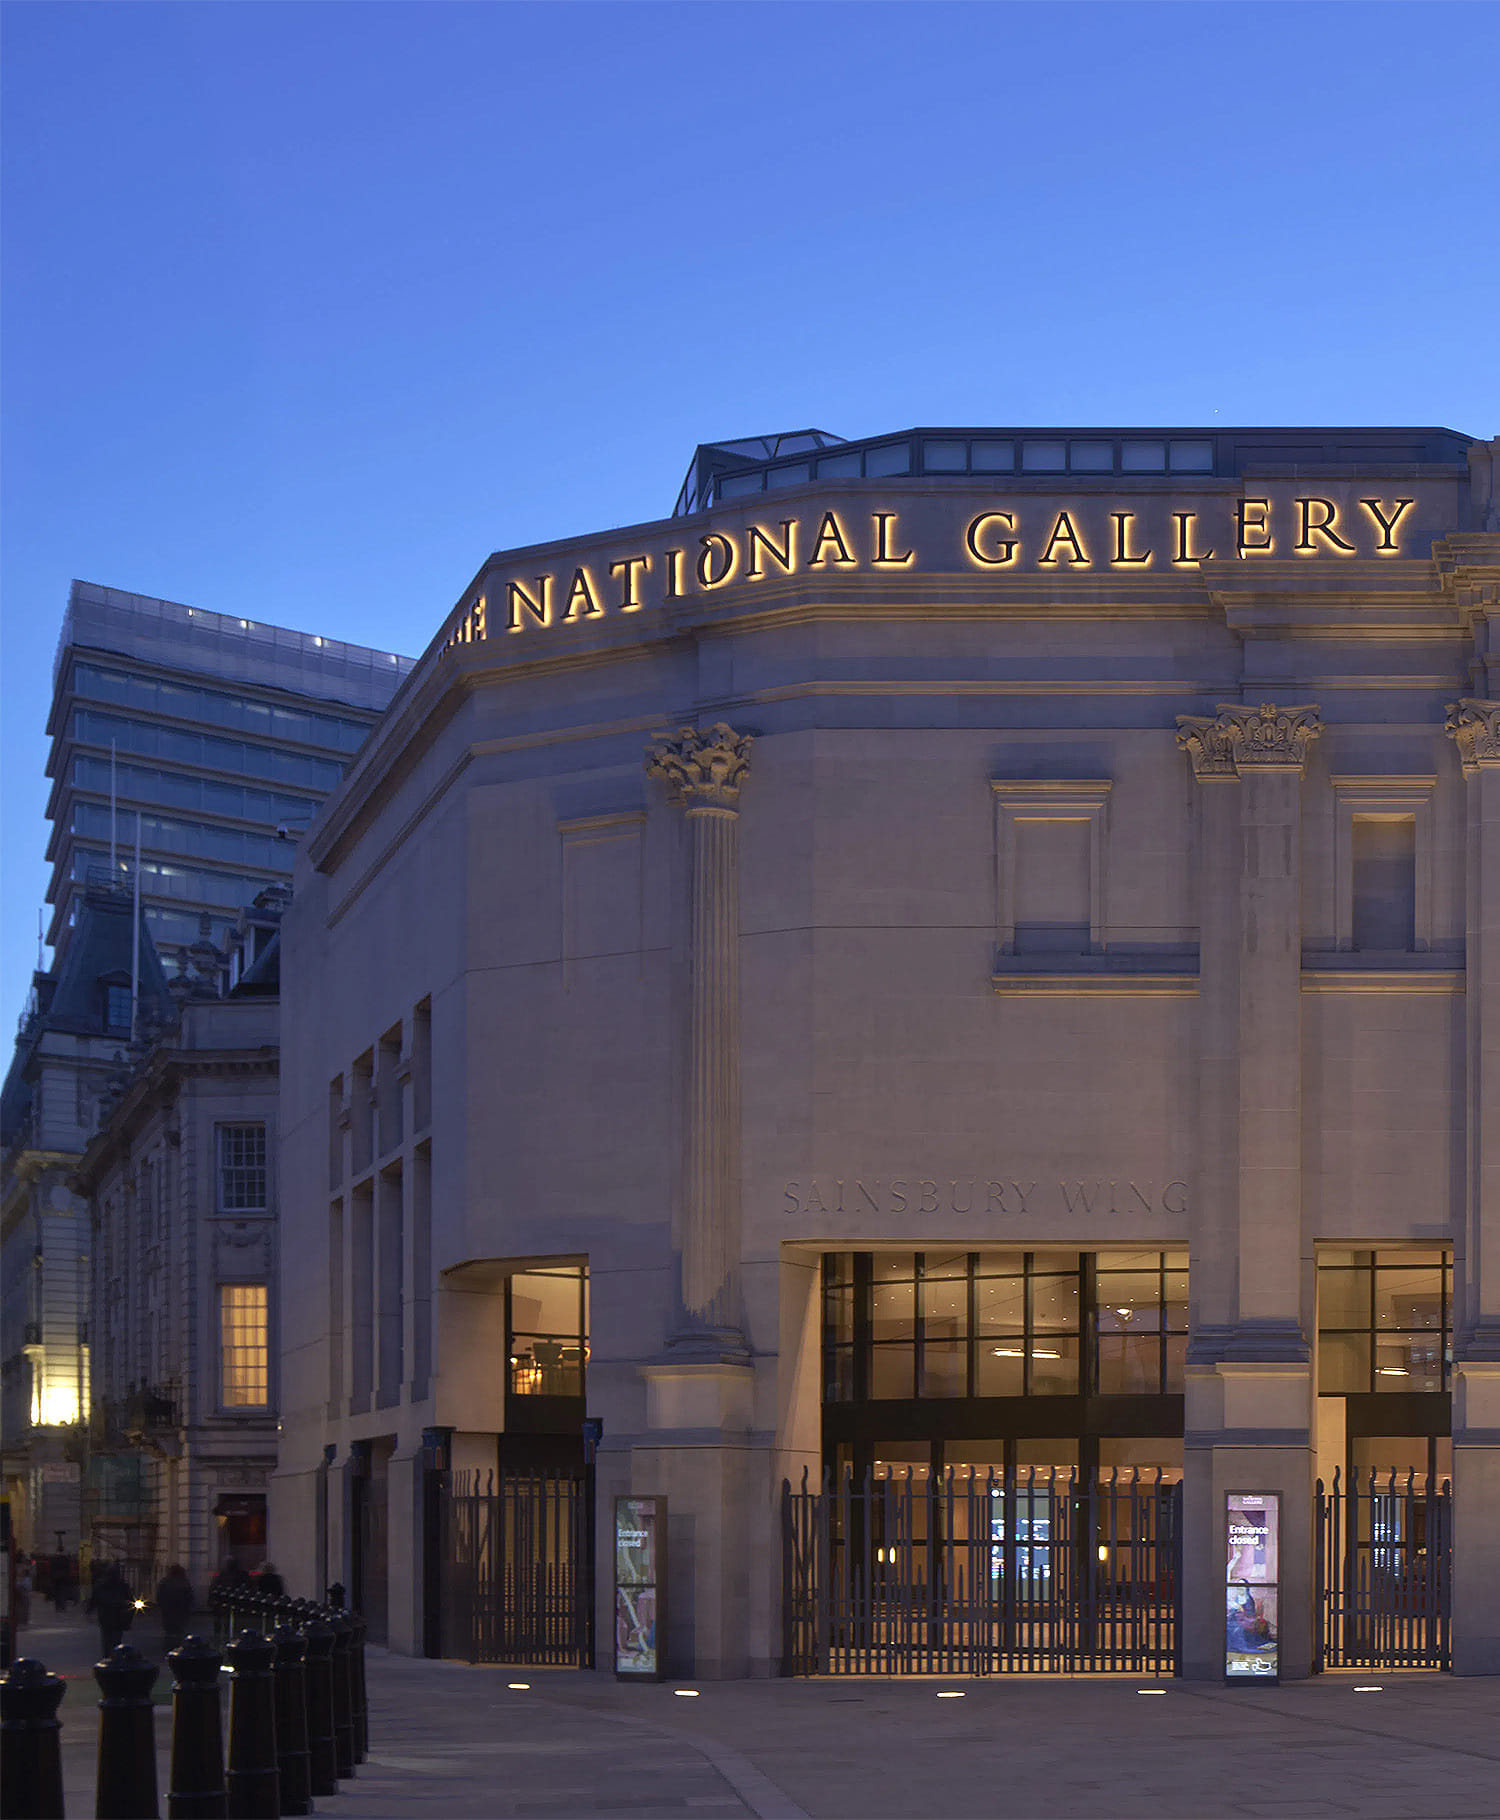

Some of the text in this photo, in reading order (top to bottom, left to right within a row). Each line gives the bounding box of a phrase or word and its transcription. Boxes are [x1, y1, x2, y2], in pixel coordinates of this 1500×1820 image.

[505, 511, 913, 631] NATIONAL
[966, 498, 1414, 564] GALLERY
[783, 1180, 1189, 1215] SAINSBURY WING
[618, 1529, 648, 1537] Entrance
[1229, 1525, 1269, 1535] Entrance
[618, 1539, 640, 1547] closed
[1229, 1535, 1259, 1545] closed
